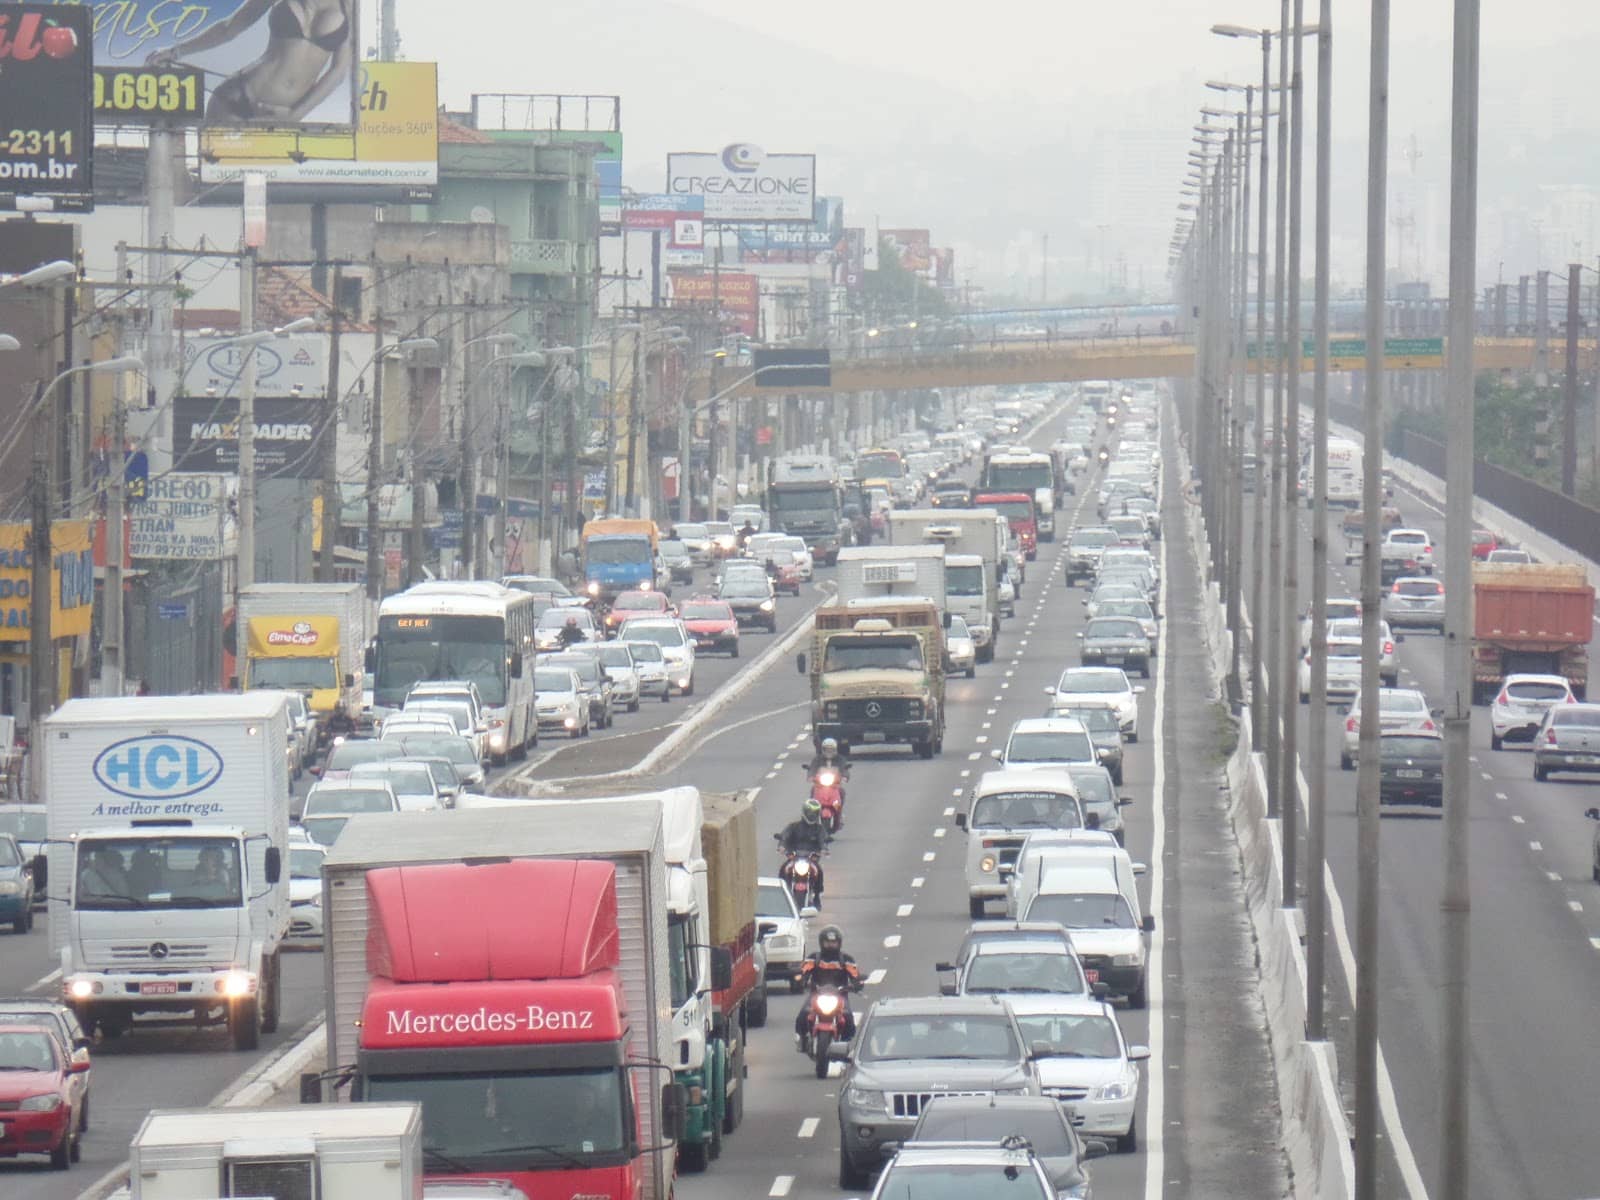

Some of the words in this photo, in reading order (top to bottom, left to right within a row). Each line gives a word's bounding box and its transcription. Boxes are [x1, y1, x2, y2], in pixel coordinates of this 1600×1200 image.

[672, 176, 809, 194] CREAZIONE
[105, 744, 213, 790] HCL
[107, 801, 160, 816] melhor
[165, 801, 224, 817] entrega.
[386, 1006, 593, 1035] Mercedes-Benz
